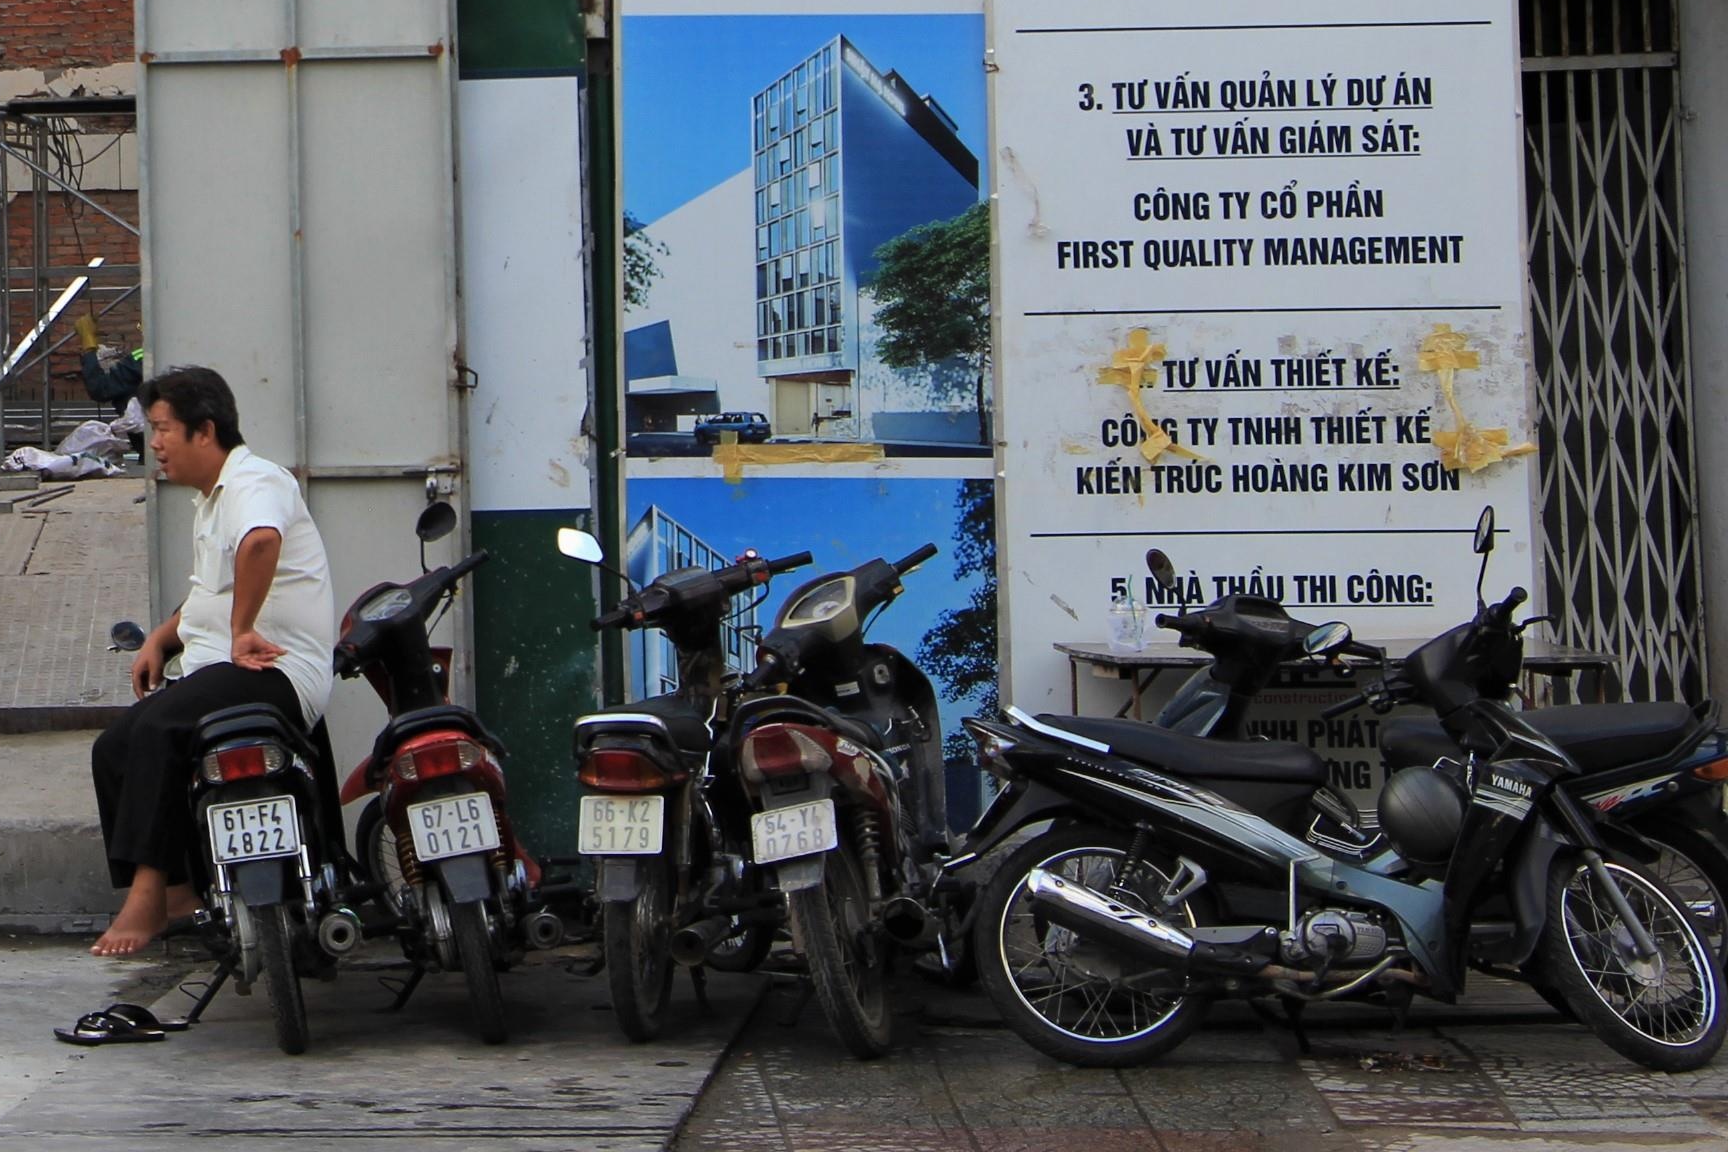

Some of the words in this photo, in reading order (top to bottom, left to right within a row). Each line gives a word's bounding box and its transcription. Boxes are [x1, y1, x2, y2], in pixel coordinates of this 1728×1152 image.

[1079, 84, 1103, 110] 3.
[1112, 79, 1149, 108] TƯ
[1155, 71, 1211, 108] VẤN
[1221, 70, 1296, 110] QUẢN
[1306, 71, 1341, 105] LÝ
[1347, 77, 1386, 112] DỰ
[1393, 69, 1432, 105] ÁN
[1127, 122, 1162, 157] VÀ
[1171, 125, 1208, 155] TƯ
[1214, 118, 1270, 155] VẤN
[1280, 121, 1352, 154] GIÁM
[1362, 121, 1421, 154] SÁT:
[1134, 187, 1210, 221] CÔNG
[1219, 191, 1250, 219] TY
[1261, 180, 1300, 219] CỔ
[1307, 180, 1383, 218] PHẦN
[1058, 239, 1134, 269] FIRST
[1144, 238, 1253, 269] QUALITY
[1264, 235, 1463, 266] MANAGEMENT
[1162, 358, 1199, 388] TƯ
[1206, 350, 1263, 388] VẤN
[1272, 350, 1348, 387] THIẾT
[1357, 348, 1401, 386] KẾ:
[1187, 418, 1218, 446] TY
[1228, 416, 1301, 445] TNHH
[1310, 406, 1387, 445] THIẾT
[1396, 405, 1431, 443] KẾ
[1076, 455, 1142, 494] KIẾN
[1150, 456, 1223, 493] TRÚC
[1232, 456, 1328, 492] HOÀNG
[1338, 462, 1392, 491] KIM
[1401, 459, 1460, 491] SƠN
[1145, 570, 1204, 605] NHÀ
[1212, 565, 1285, 603] THẦU
[1294, 576, 1336, 602] THI
[1346, 569, 1433, 602] CÔNG:
[1308, 715, 1380, 748] PHÁT
[1491, 774, 1533, 798] YAMAHA
[222, 803, 283, 831] 61-F4
[422, 800, 479, 826] 67-L6
[593, 801, 648, 825] 66-K2
[227, 827, 286, 856] 4822
[427, 823, 485, 853] 0121
[592, 825, 648, 850] 5179
